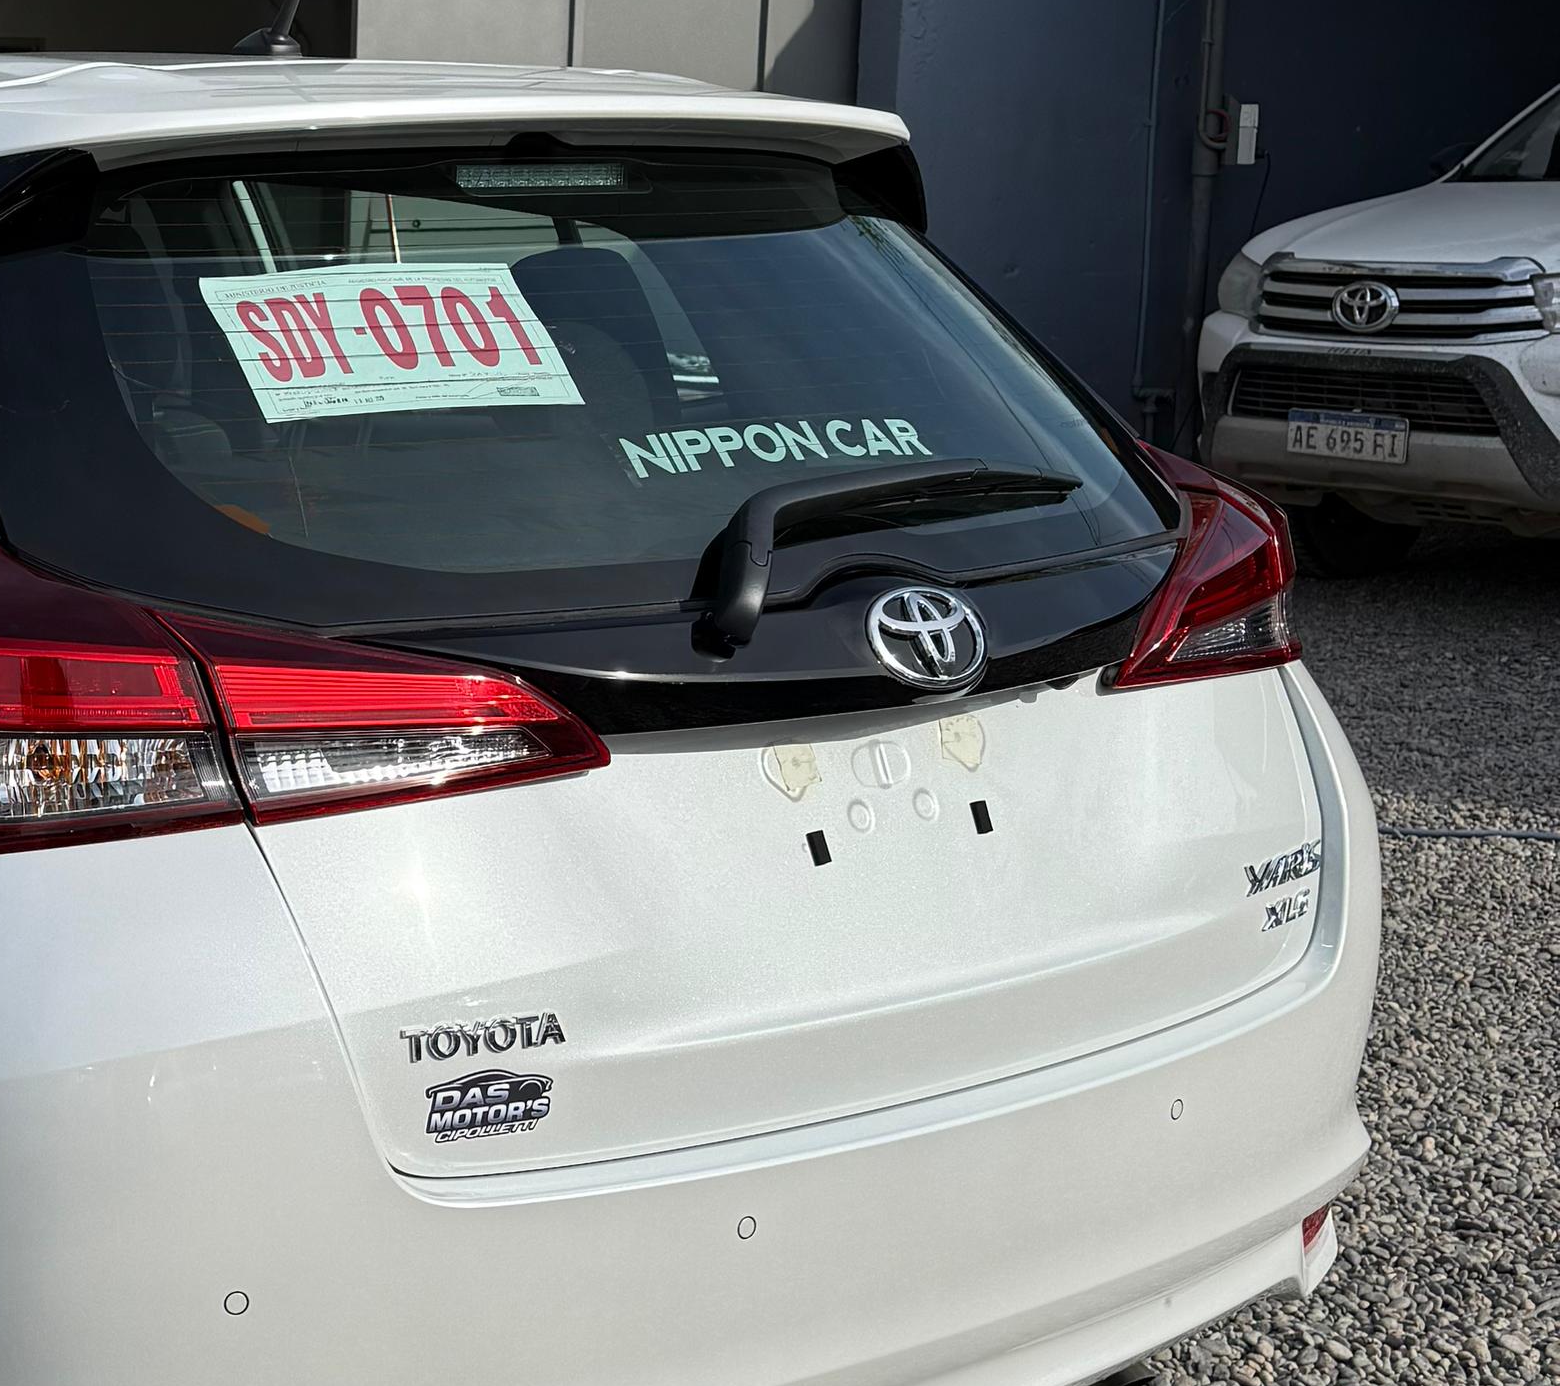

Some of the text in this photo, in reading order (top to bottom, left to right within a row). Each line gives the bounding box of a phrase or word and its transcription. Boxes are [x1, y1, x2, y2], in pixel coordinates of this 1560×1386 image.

[618, 418, 933, 479] NIPPON CAR
[1292, 424, 1318, 450] AE
[1326, 428, 1365, 454] 695
[400, 1011, 566, 1063] TOYOTA
[434, 1083, 510, 1111] DAS
[428, 1098, 550, 1132] MOTOR'S
